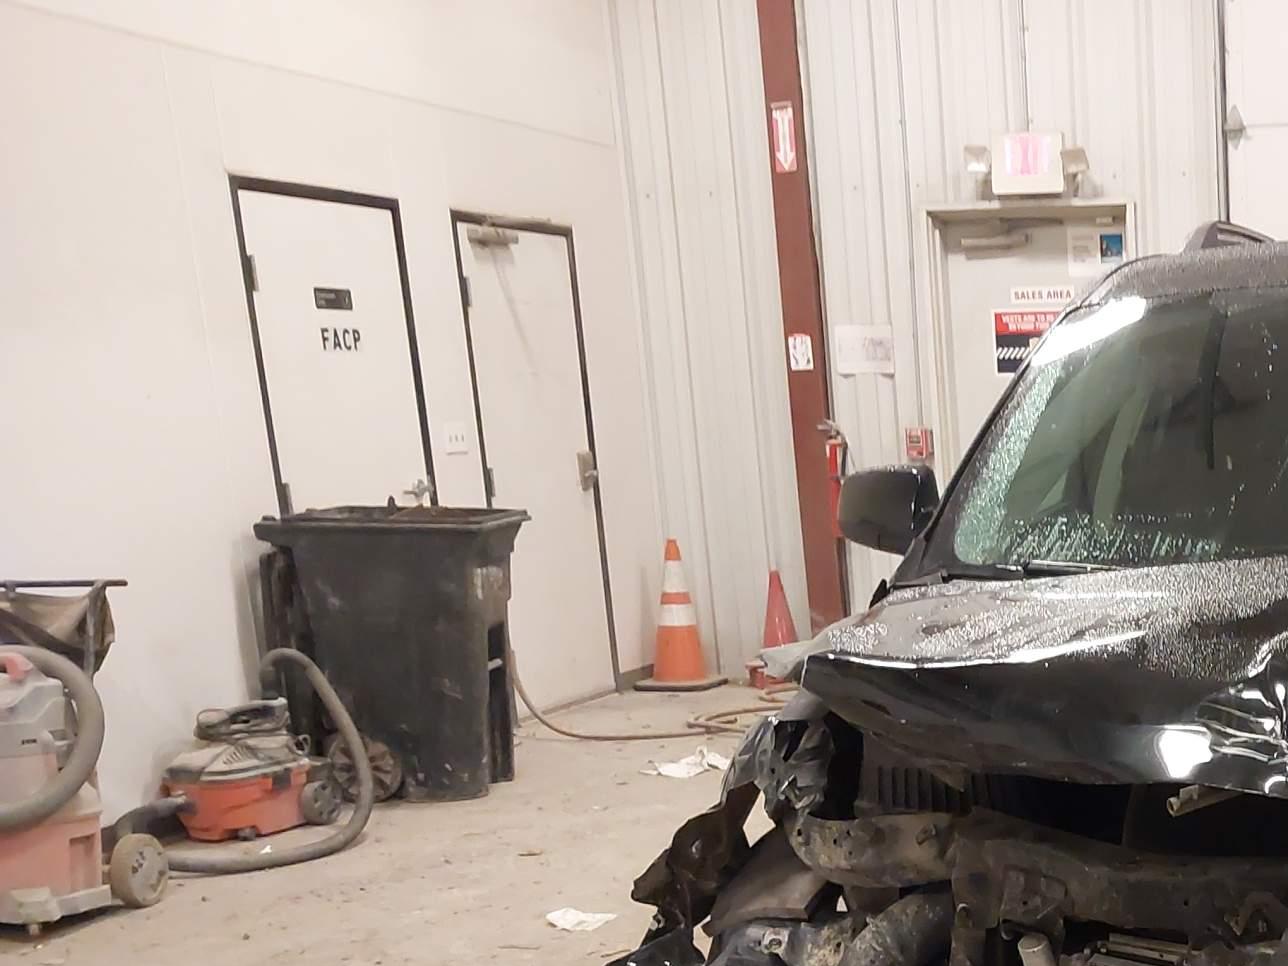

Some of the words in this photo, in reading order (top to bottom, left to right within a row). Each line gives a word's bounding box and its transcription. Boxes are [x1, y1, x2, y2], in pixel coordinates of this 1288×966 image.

[1014, 290, 1043, 300] SALES
[1047, 289, 1072, 300] AREA
[320, 327, 361, 351] FACP
